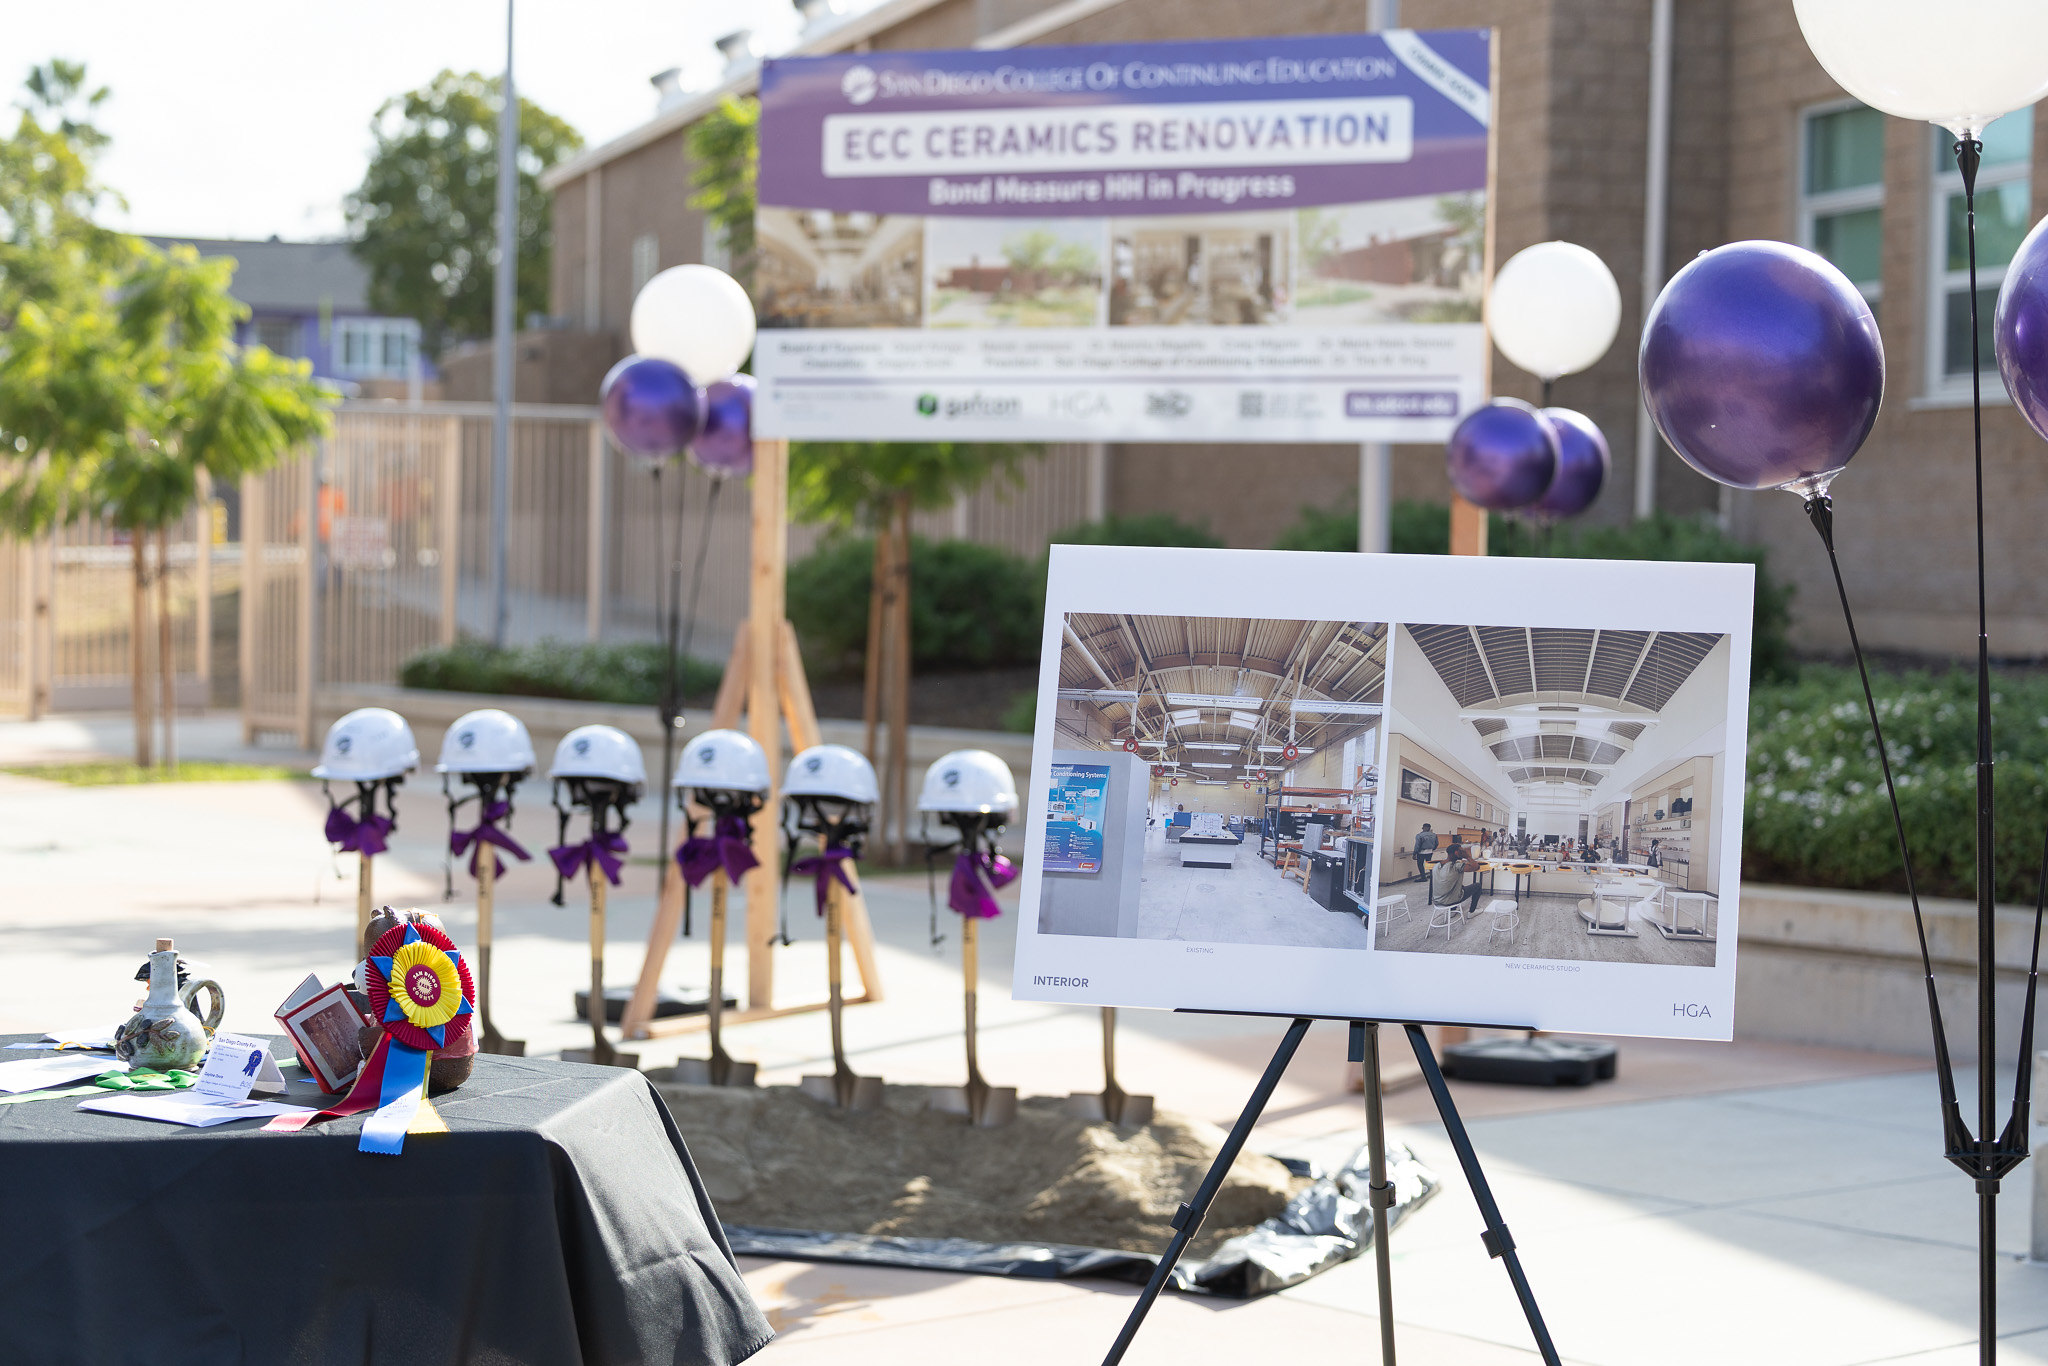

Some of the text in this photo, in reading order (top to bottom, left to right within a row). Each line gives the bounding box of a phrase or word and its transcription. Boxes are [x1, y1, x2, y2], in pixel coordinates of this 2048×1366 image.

[880, 56, 1397, 98] SAN DIEGO COLLEGE OF CONTINUING EDUCATION
[844, 113, 1389, 161] ECC CERAMICS RENOVATION
[929, 176, 992, 204] Bond
[994, 175, 1102, 203] Measure
[1148, 172, 1174, 200] in
[1177, 171, 1296, 204] Progress
[1053, 770, 1107, 779] Conditioning Systems
[1186, 946, 1214, 954] EXISTING
[1505, 962, 1581, 972] NEW CERAMICS STUDIO
[412, 970, 438, 988] SAN DIEGO
[1033, 975, 1090, 988] INTERIOR
[412, 986, 435, 1001] COUNTY
[1672, 1003, 1712, 1018] HGA
[226, 1038, 236, 1046] Diego
[236, 1040, 249, 1048] County
